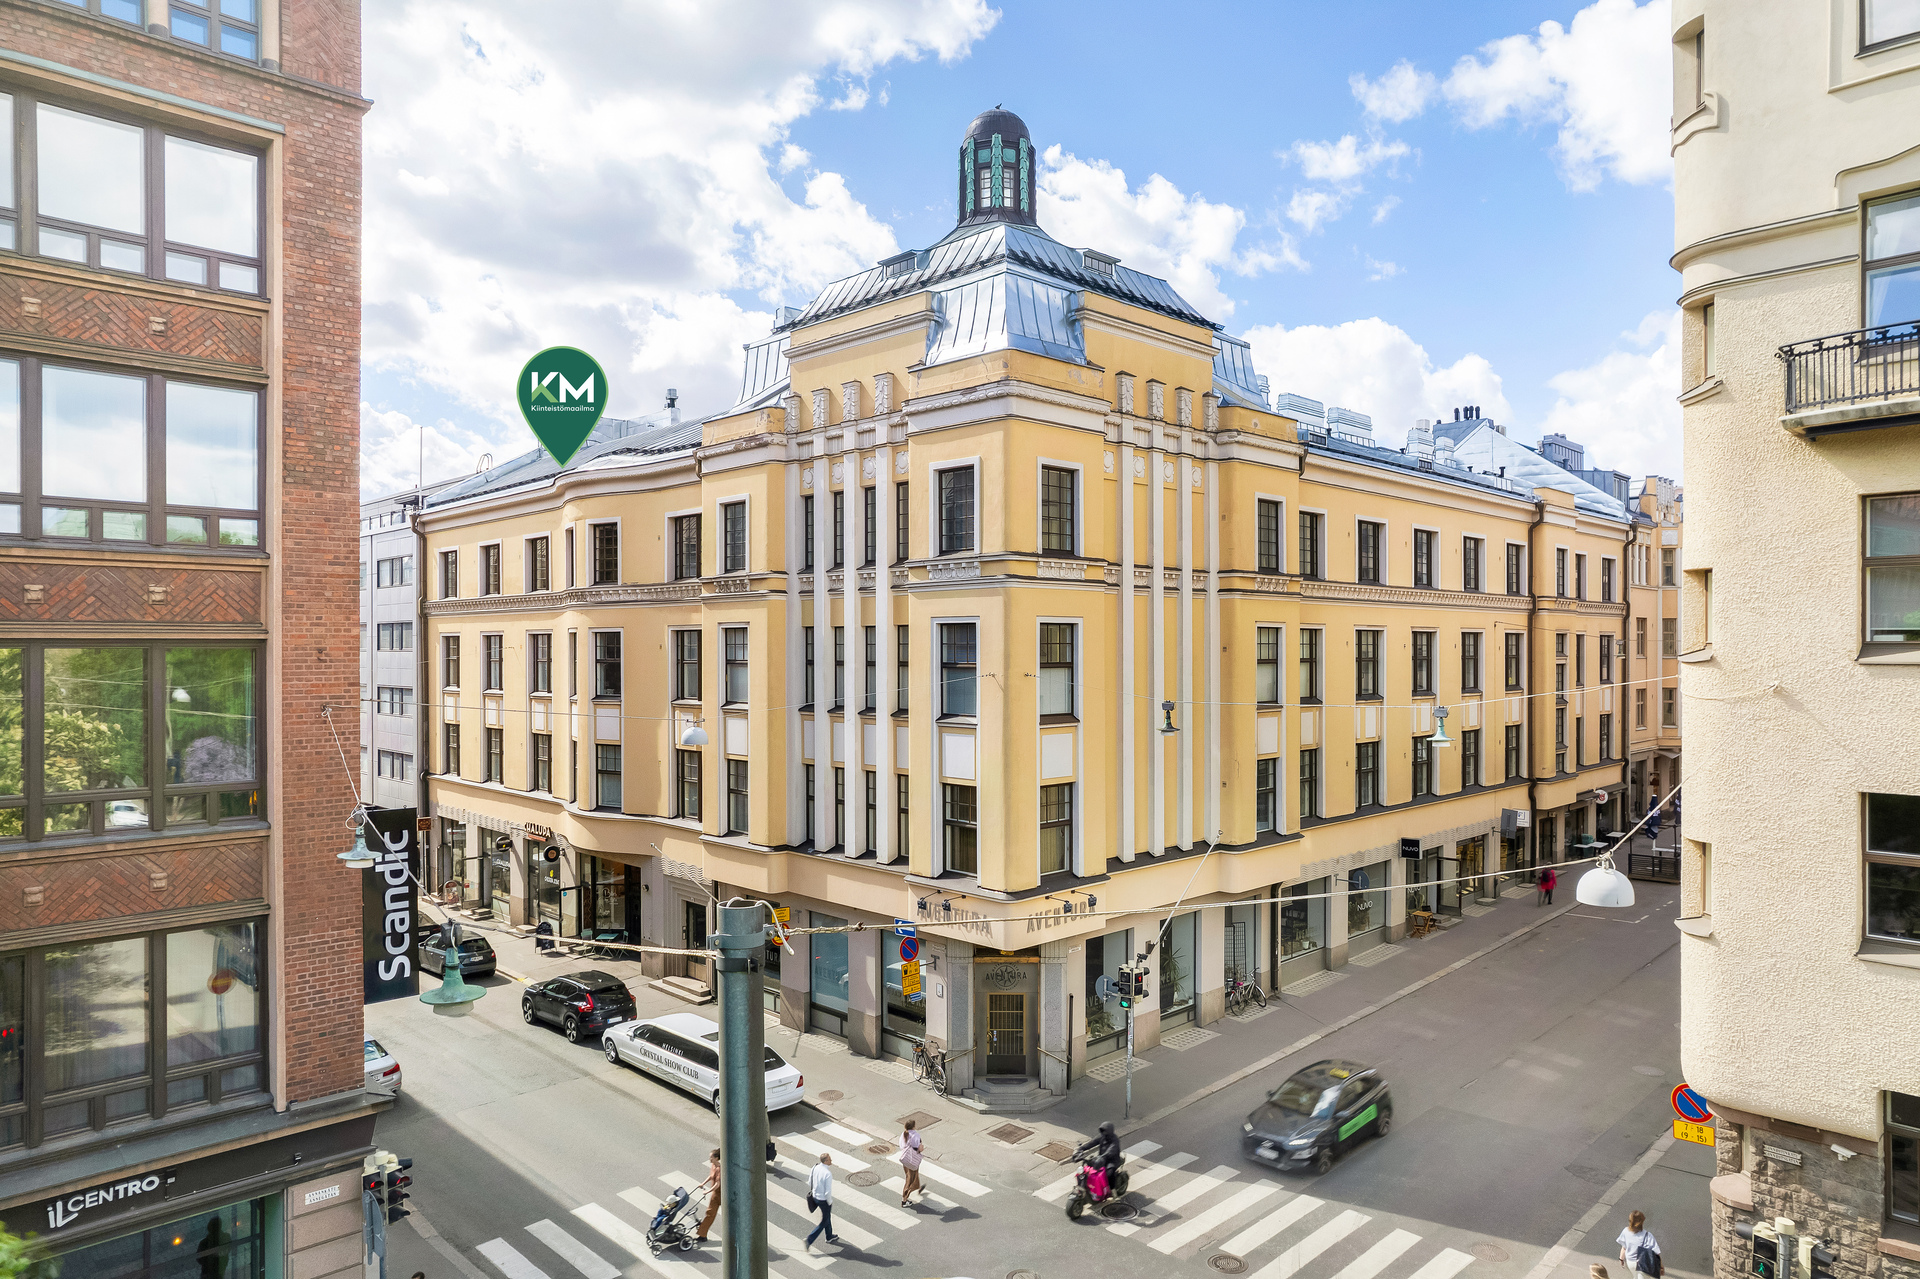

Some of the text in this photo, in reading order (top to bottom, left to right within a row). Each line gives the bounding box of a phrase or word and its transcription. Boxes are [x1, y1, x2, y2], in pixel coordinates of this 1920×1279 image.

[375, 829, 411, 981] Scandic
[1357, 900, 1373, 911] NUVO
[985, 971, 1027, 981] AVENTURA
[640, 1045, 699, 1079] CRYSTAL SHOW CLUB
[1697, 1126, 1704, 1134] 18
[1697, 1135, 1707, 1143] 15)
[67, 1175, 160, 1212] CENTRO
